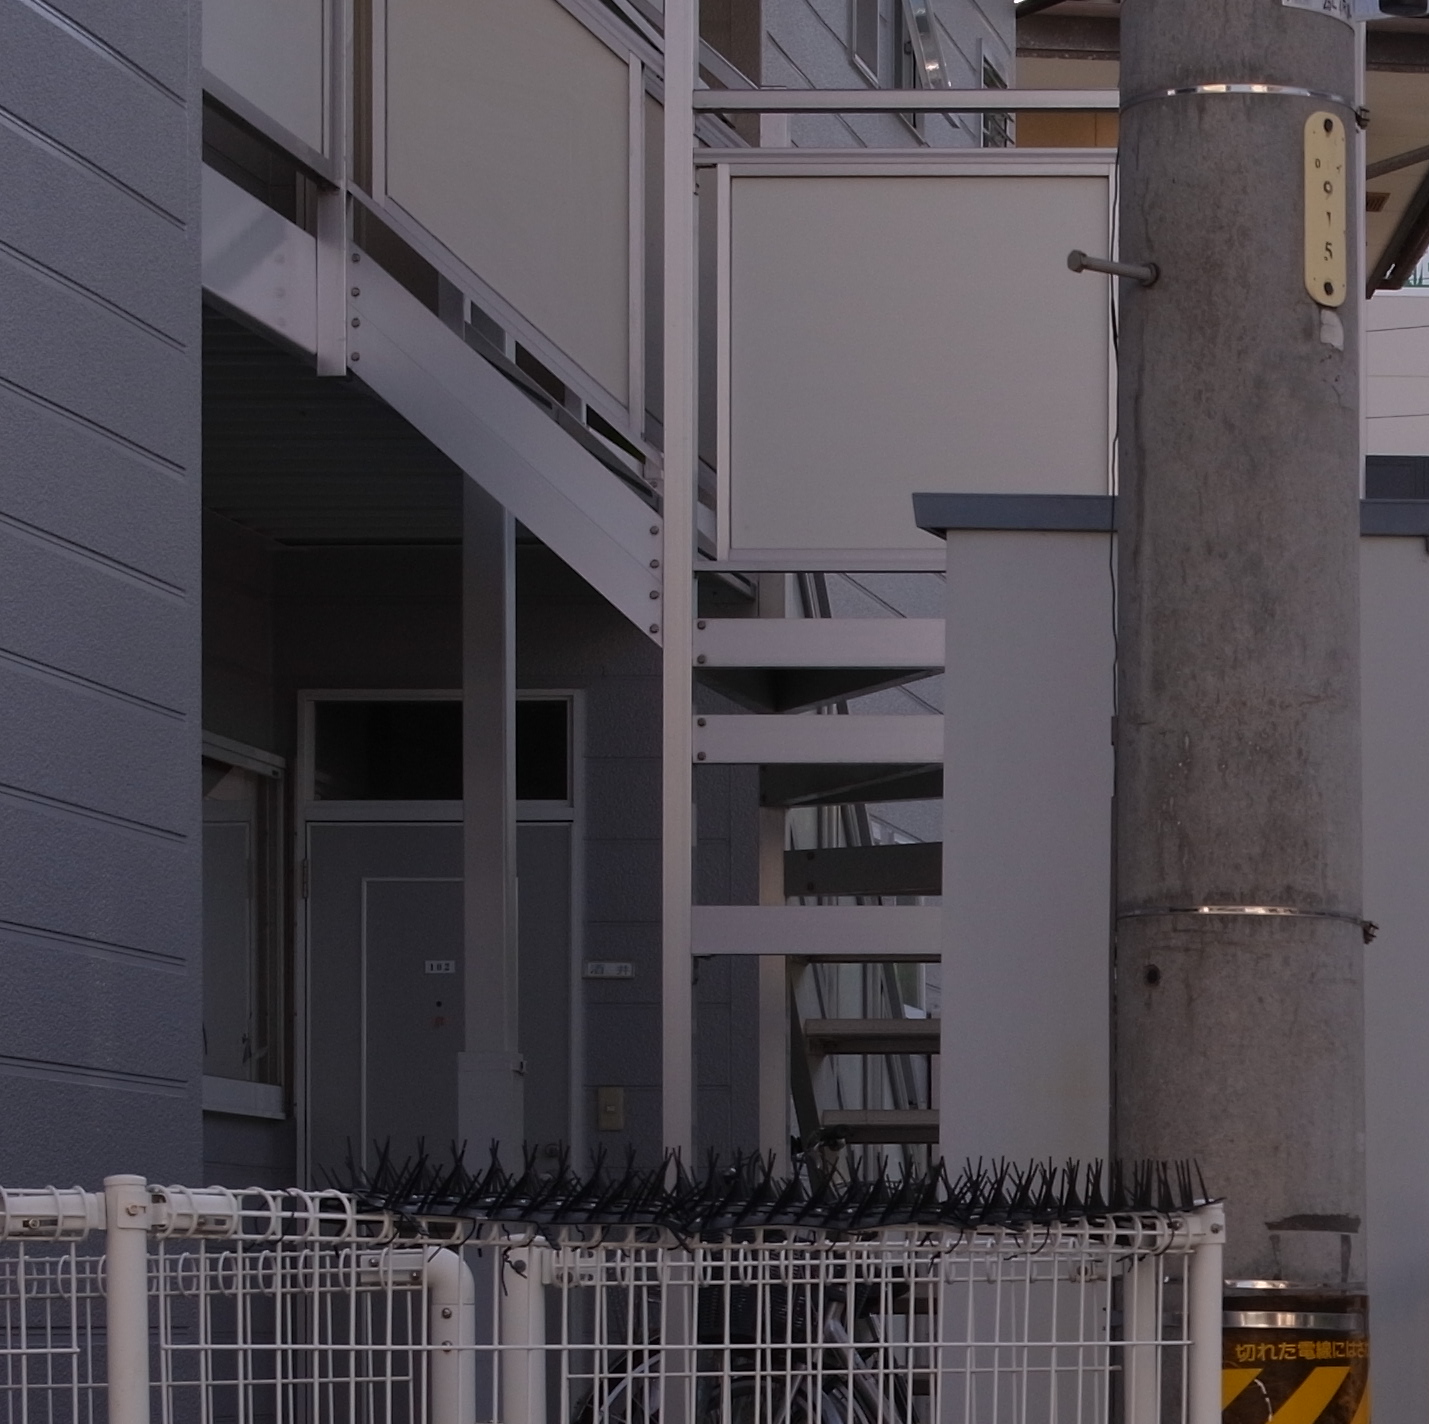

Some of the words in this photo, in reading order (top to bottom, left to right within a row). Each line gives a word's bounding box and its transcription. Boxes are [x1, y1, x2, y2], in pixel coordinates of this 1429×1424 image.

[1235, 1340, 1369, 1363] 切れた電線にはさ
